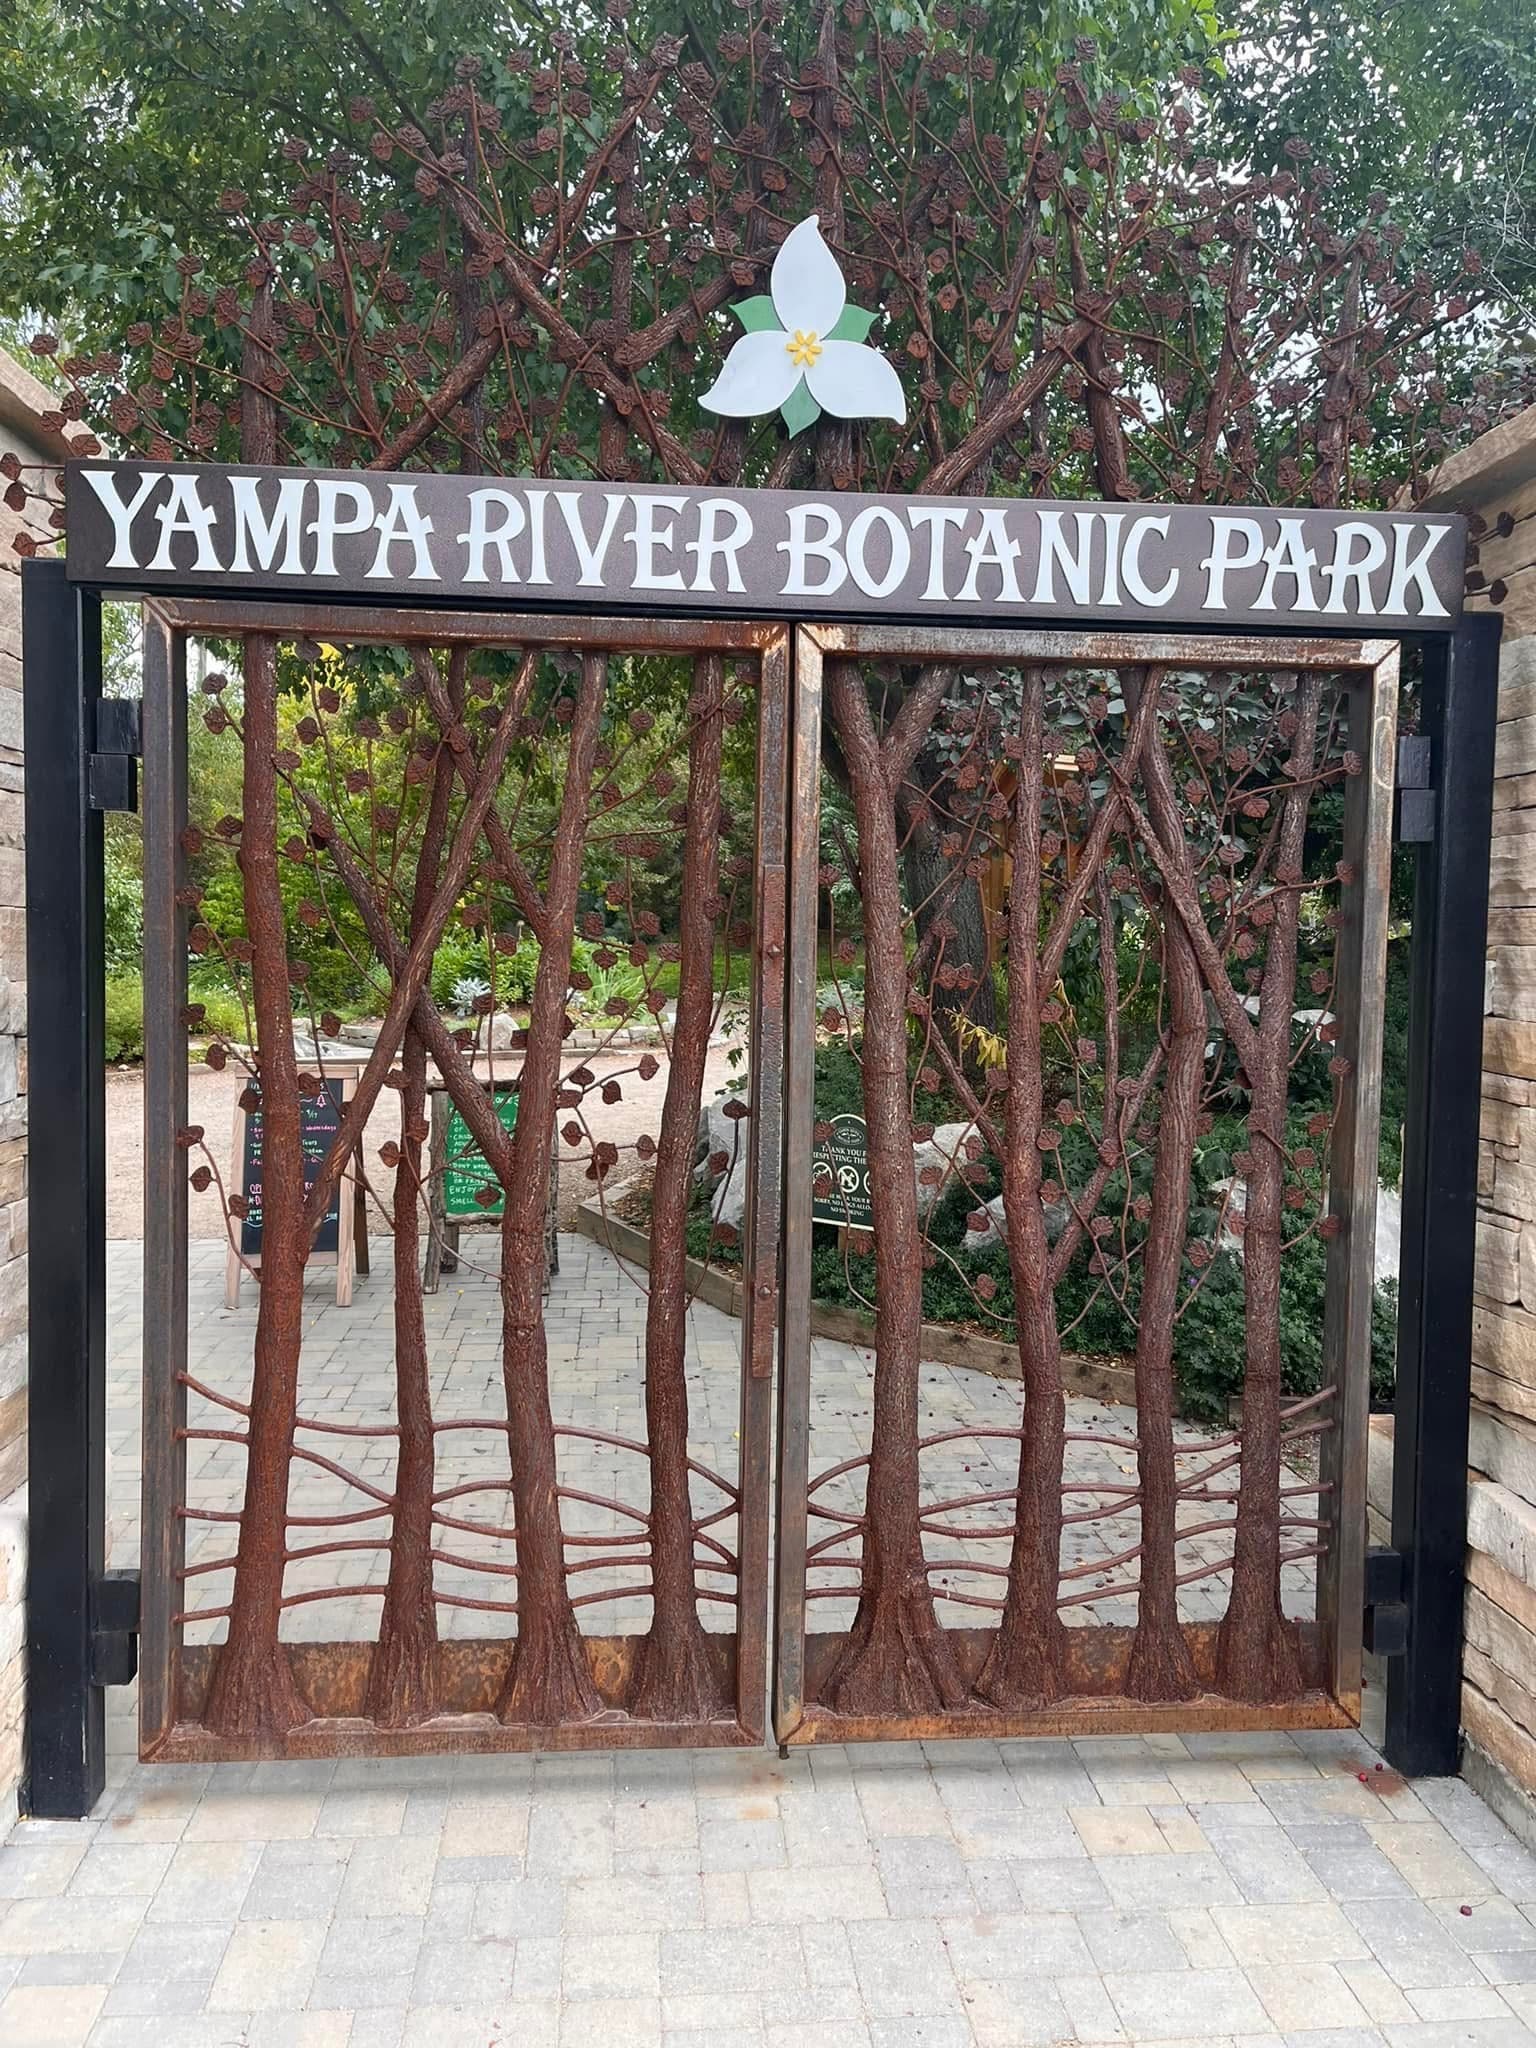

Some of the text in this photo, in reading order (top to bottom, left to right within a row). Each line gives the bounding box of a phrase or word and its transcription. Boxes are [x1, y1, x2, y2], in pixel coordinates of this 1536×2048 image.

[80, 469, 1453, 618] YAMPA RIVER BOTANIC PARK
[821, 1145, 846, 1155] TANK
[449, 1185, 477, 1195] ENJOY
